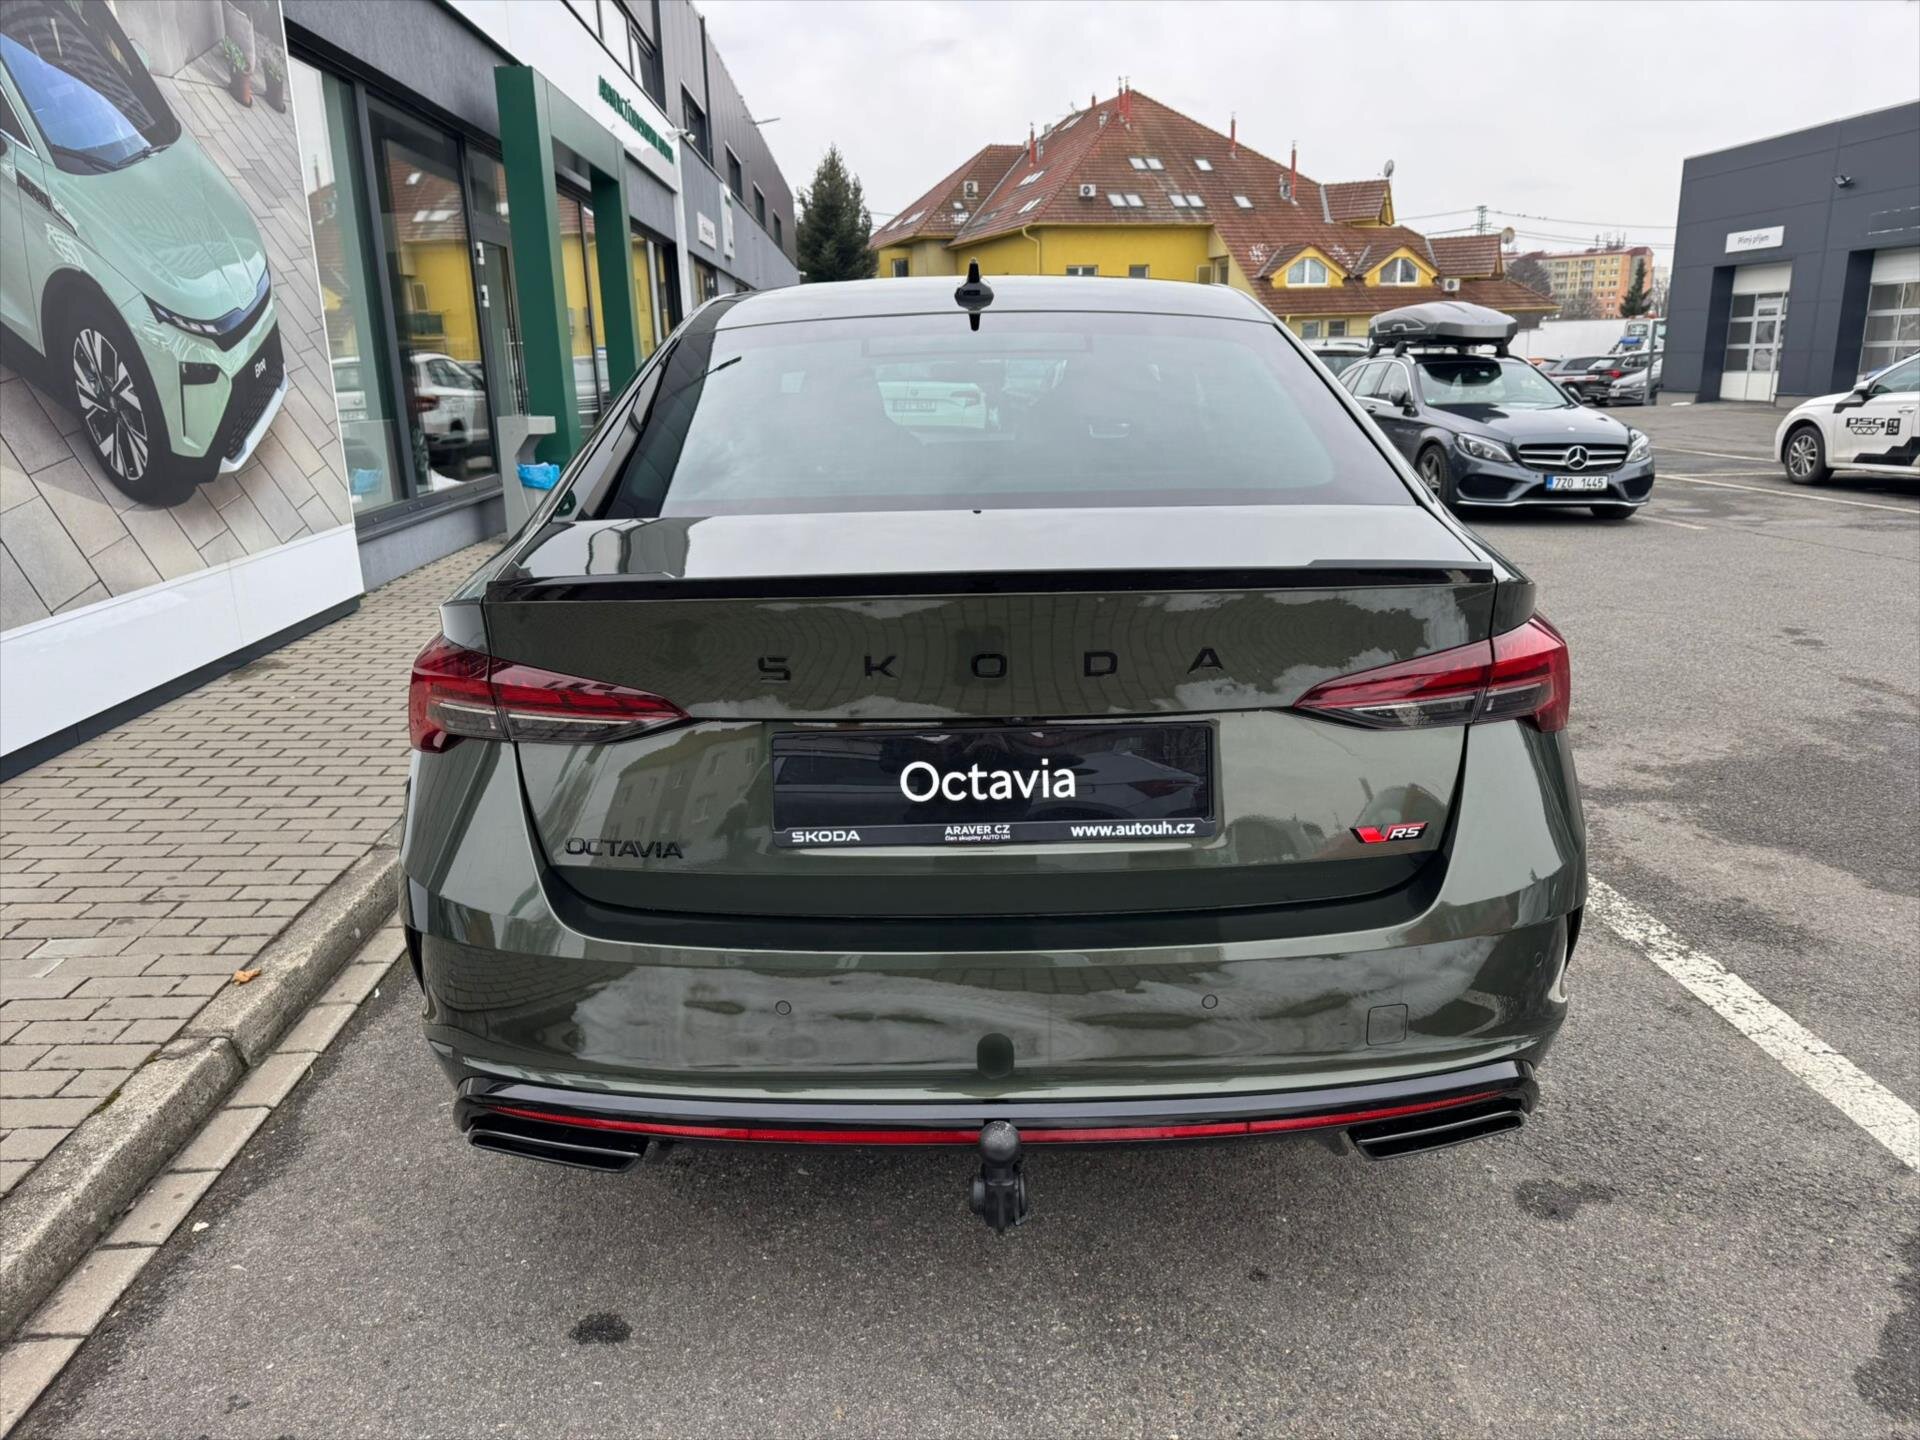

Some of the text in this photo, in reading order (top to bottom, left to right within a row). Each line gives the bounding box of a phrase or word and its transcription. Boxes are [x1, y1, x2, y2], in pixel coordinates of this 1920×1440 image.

[1581, 478, 1604, 488] 1445
[900, 758, 1076, 802] Octavia
[944, 824, 1011, 835] ARAVER CZ
[1070, 820, 1196, 837] www.autouh.cz
[982, 833, 1000, 841] AUTO
[564, 837, 684, 860] OCTAVIA
